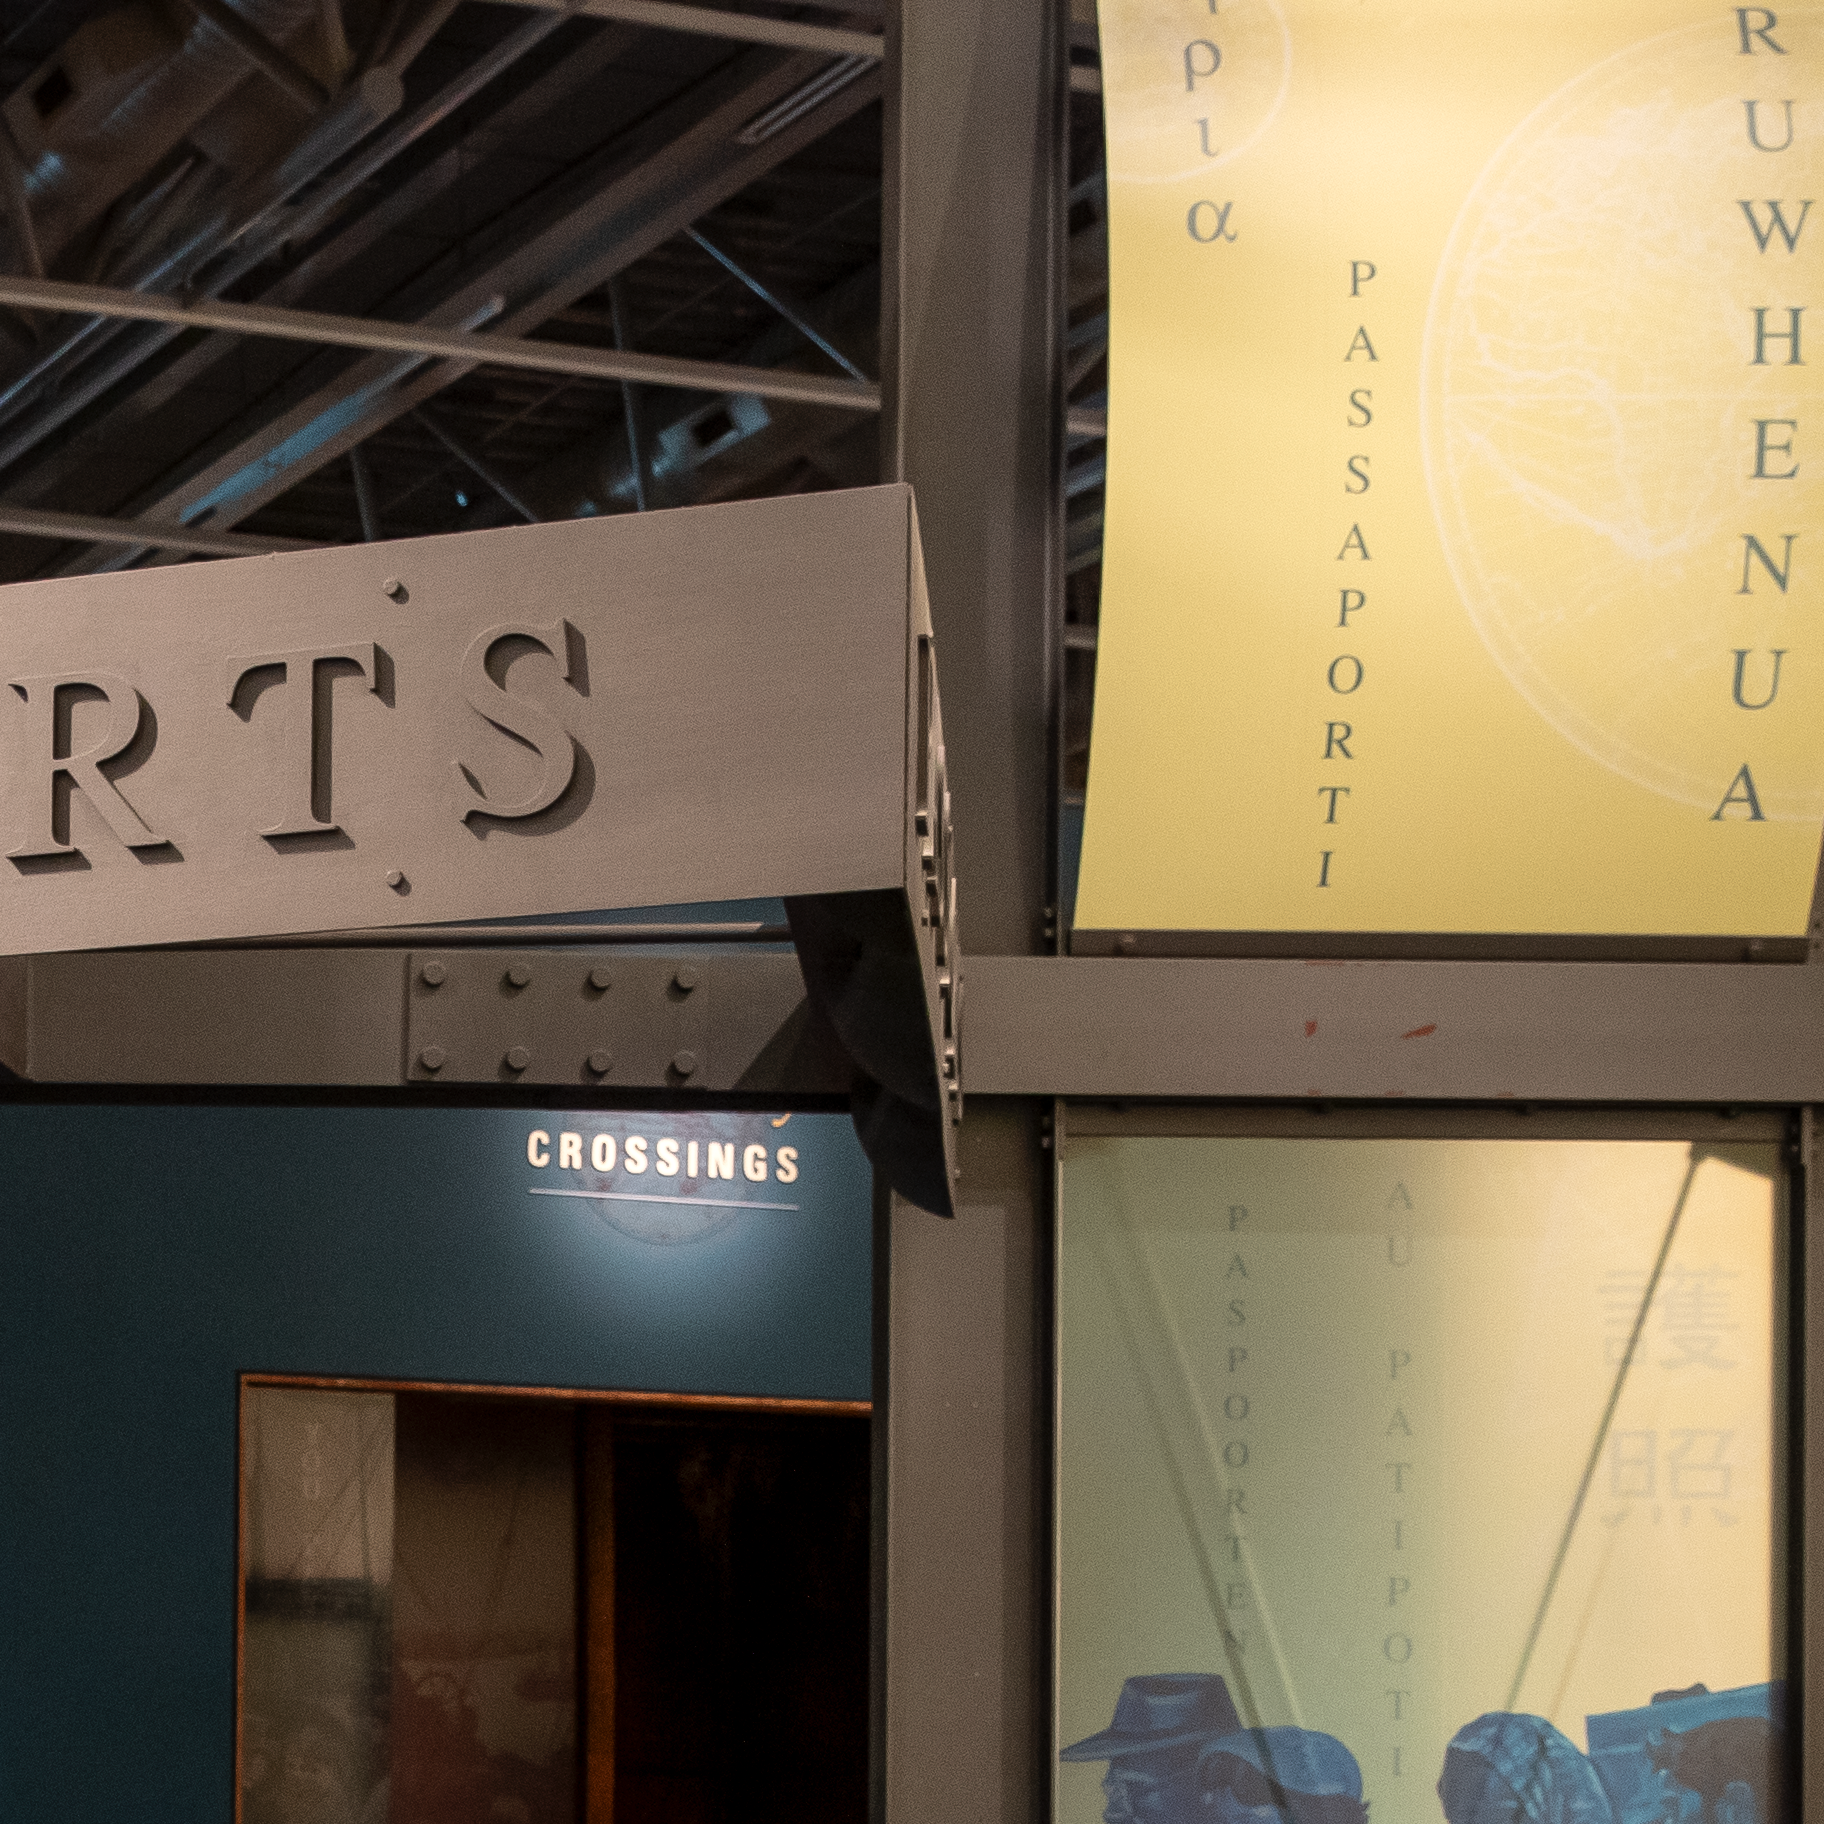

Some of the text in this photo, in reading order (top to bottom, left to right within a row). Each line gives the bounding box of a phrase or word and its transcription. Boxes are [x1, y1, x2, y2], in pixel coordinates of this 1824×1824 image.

[1183, 0, 1238, 243] ρια
[1315, 259, 1379, 889] PASSAPORTI
[1709, 6, 1815, 822] RUWHENUA
[526, 1129, 800, 1184] CROSSINGS
[1222, 1203, 1251, 1659] PASPOORTEN
[1381, 1348, 1415, 1779] PATIPOTI
[1596, 1261, 1742, 1530] 護照
